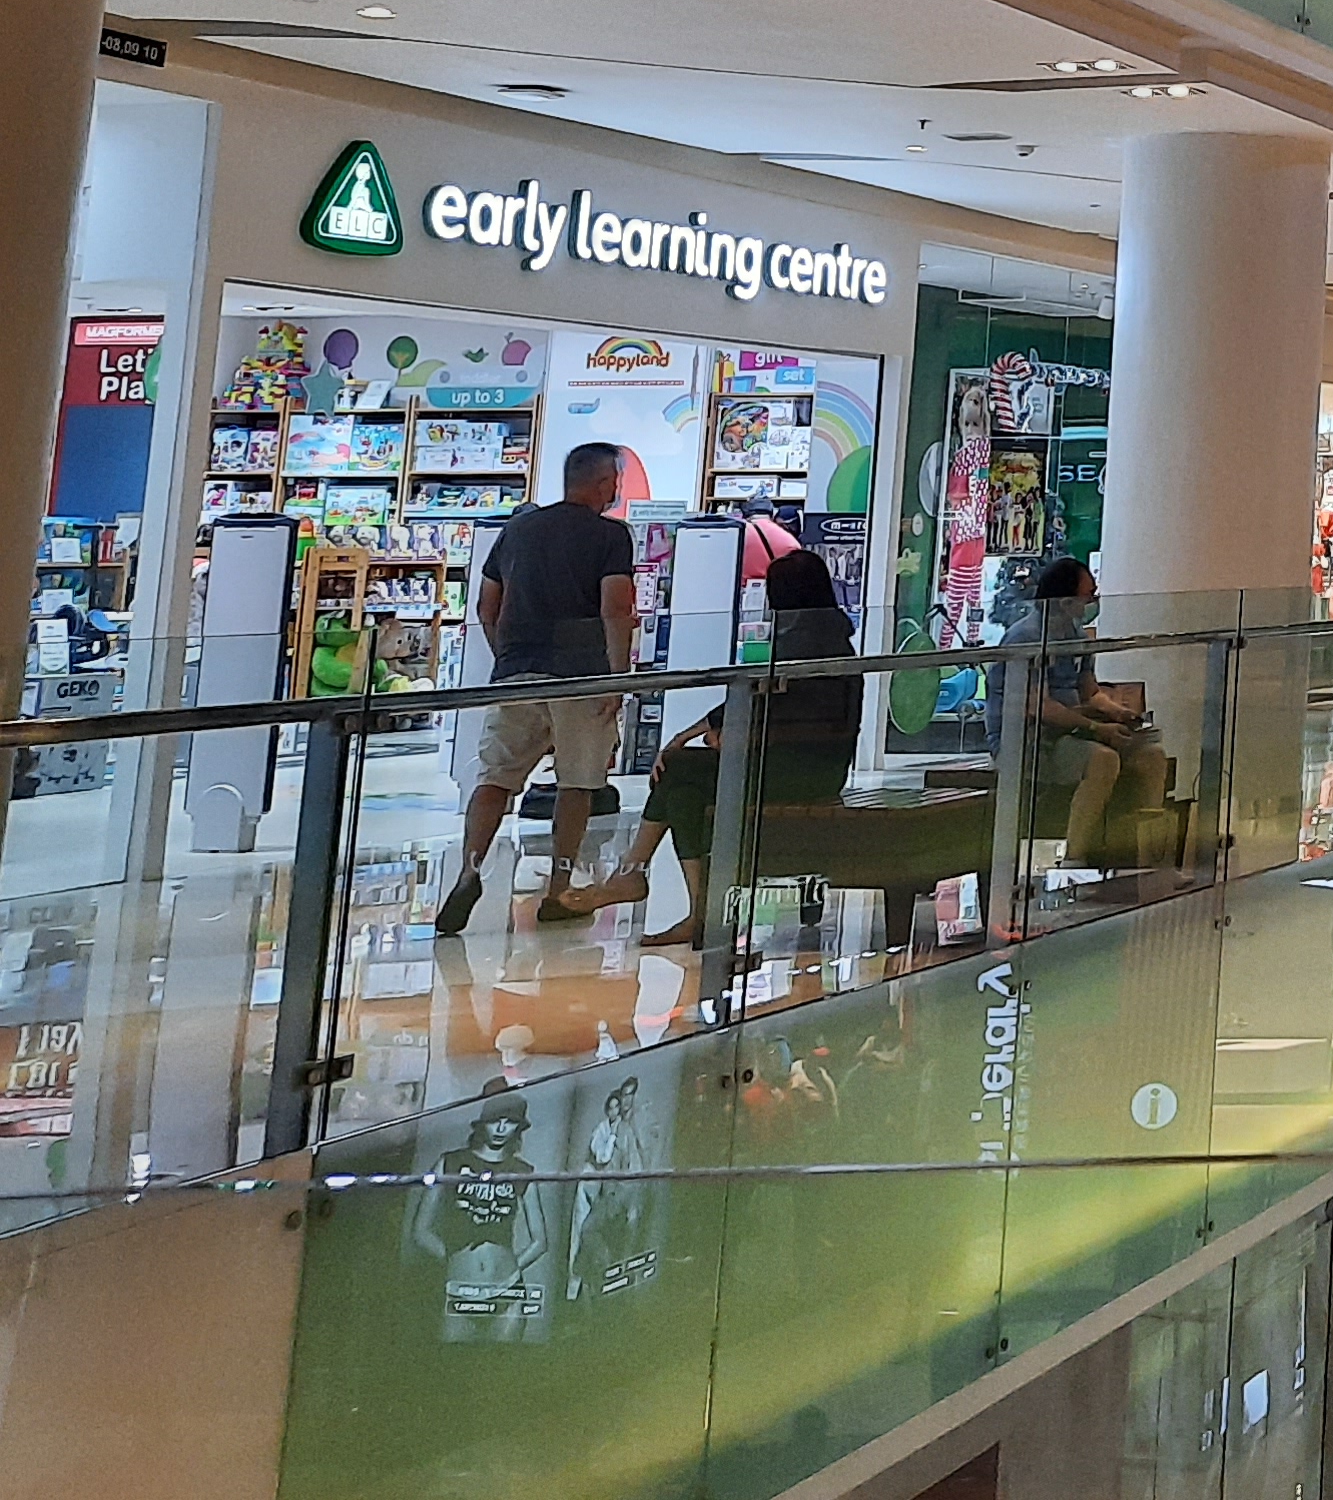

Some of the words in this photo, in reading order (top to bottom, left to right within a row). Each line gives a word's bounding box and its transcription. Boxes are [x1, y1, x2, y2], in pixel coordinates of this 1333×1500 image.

[332, 208, 387, 237] ELC
[426, 178, 568, 272] early
[570, 189, 766, 301] learning
[765, 243, 887, 304] centre
[586, 352, 671, 373] happyland
[451, 390, 471, 406] up
[476, 389, 491, 403] to
[493, 389, 505, 403] 3
